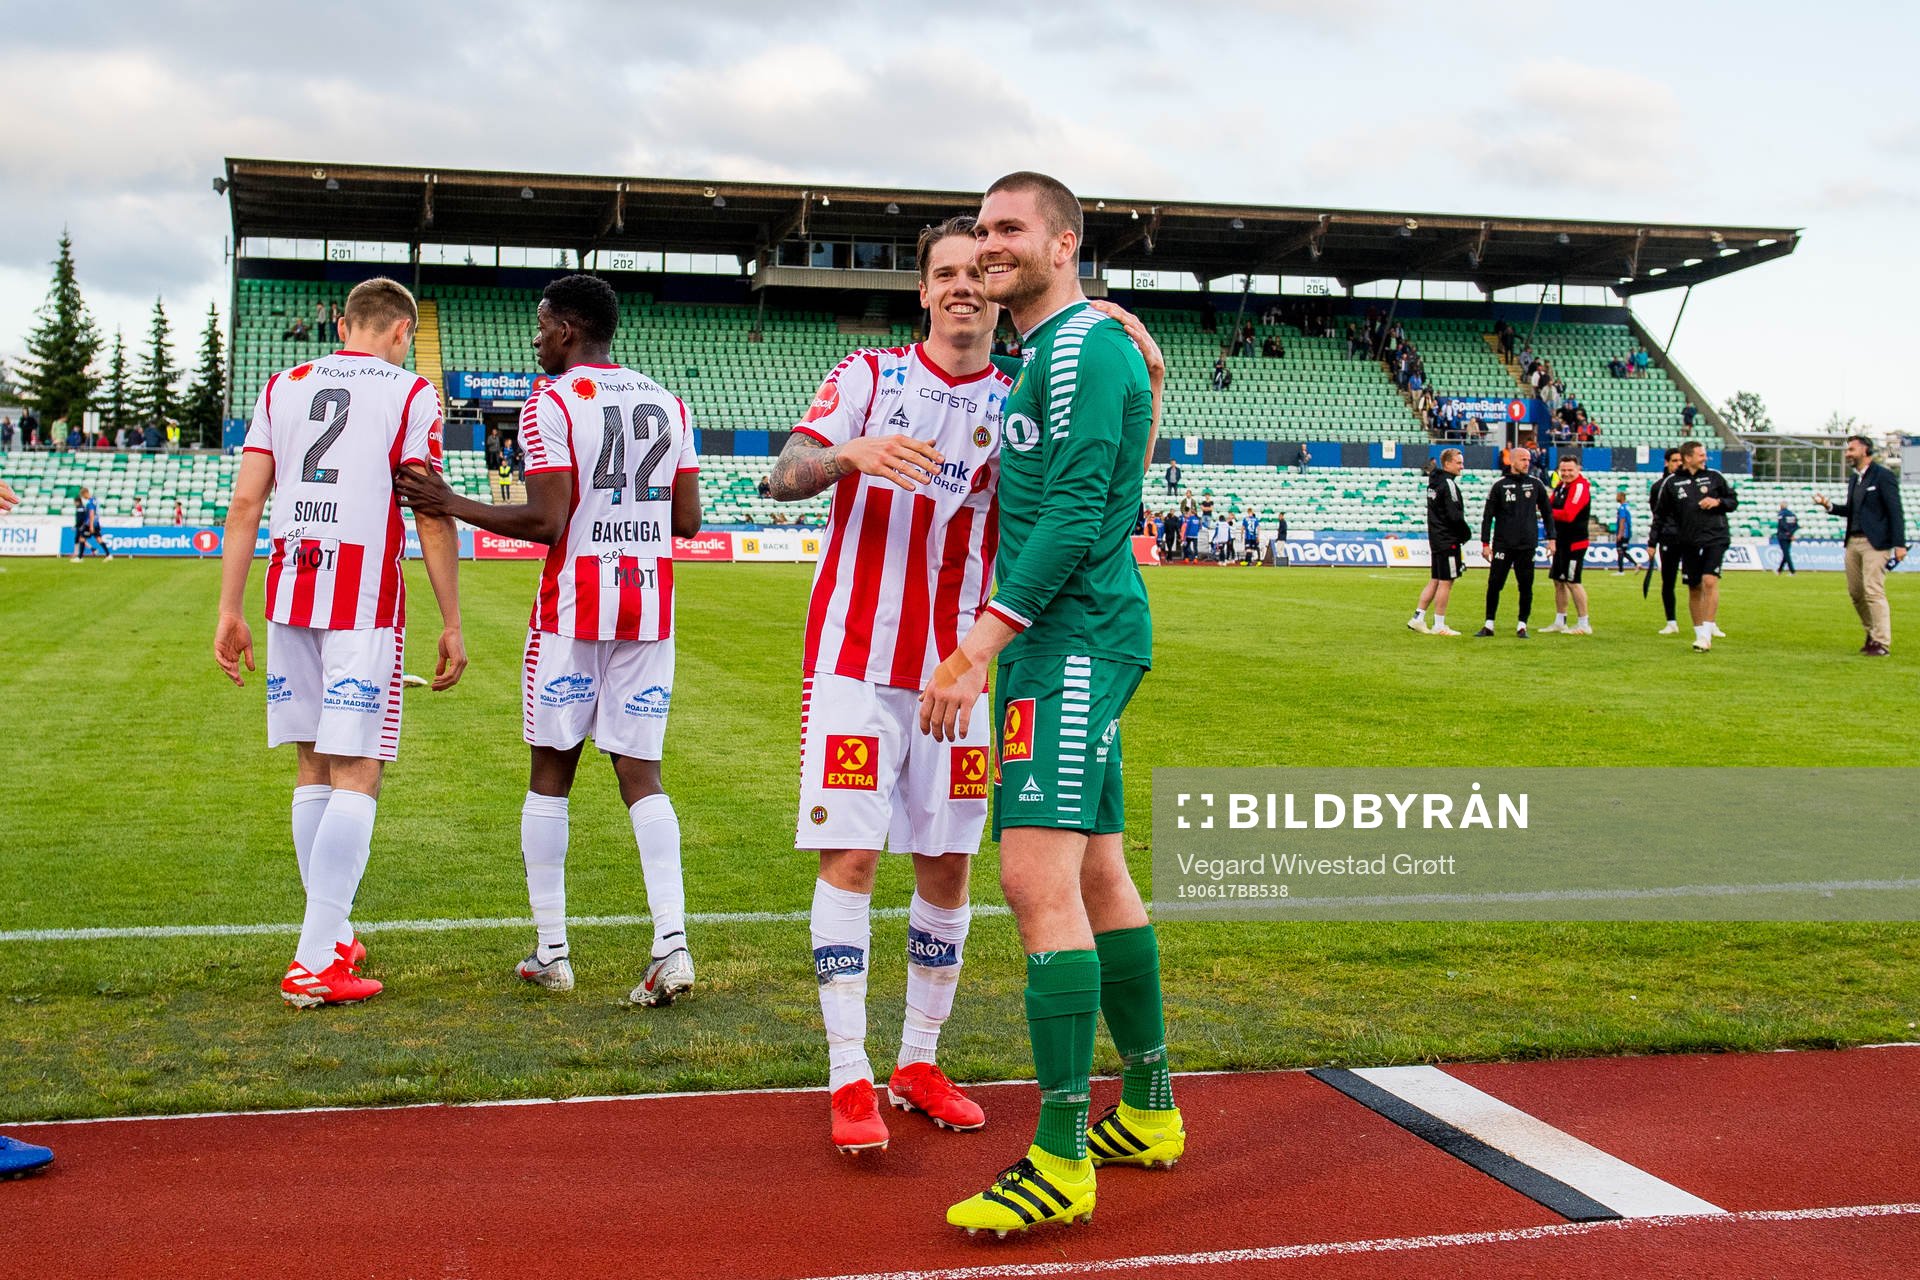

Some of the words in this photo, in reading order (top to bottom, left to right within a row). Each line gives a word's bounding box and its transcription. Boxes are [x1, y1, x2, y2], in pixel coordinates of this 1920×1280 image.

[331, 248, 351, 260] 201
[613, 259, 634, 269] 202
[1136, 278, 1155, 288] 204
[1306, 285, 1324, 294] 205
[316, 366, 356, 378] TROMS
[359, 367, 400, 380] KRAFT
[464, 375, 530, 389] SpareBank
[481, 389, 531, 397] ØSTLANDET
[1452, 400, 1507, 412] SpareBank
[301, 388, 351, 484] 2
[1012, 420, 1026, 444] 1
[593, 403, 671, 505] 42
[294, 500, 338, 523] SOKOL
[0, 527, 37, 543] FISH
[591, 520, 661, 543] BAKENGA
[102, 534, 190, 550] SpareBank
[482, 537, 534, 548] Scandic
[675, 538, 726, 550] Scandic
[293, 546, 336, 570] MOT
[1275, 542, 1384, 562] macron
[614, 566, 655, 589] MOT
[625, 702, 649, 713] ROALD
[1003, 742, 1027, 756] TRA
[827, 773, 874, 787] EXTRA
[1018, 793, 1044, 802] SELECT
[816, 955, 862, 975] LERØY
